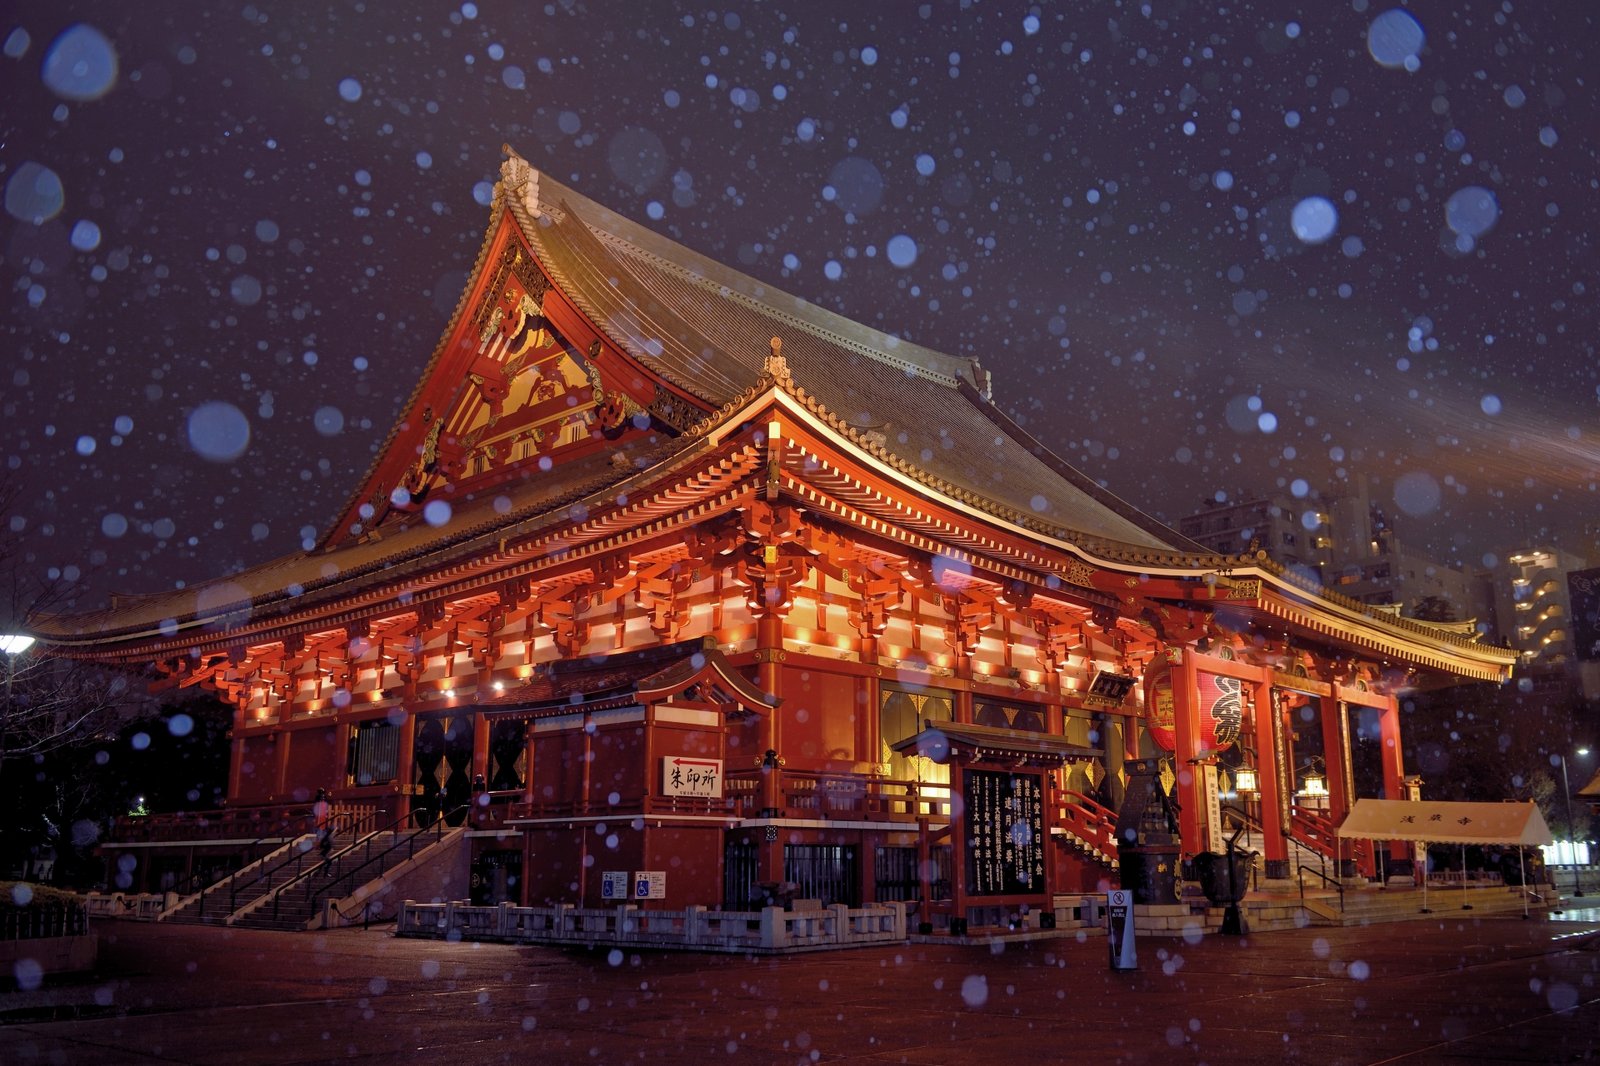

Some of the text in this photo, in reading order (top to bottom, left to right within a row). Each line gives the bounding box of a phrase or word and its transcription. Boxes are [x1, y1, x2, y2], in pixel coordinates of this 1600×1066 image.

[671, 766, 716, 791] 朱印所
[1034, 788, 1042, 875] 本堂連日法会
